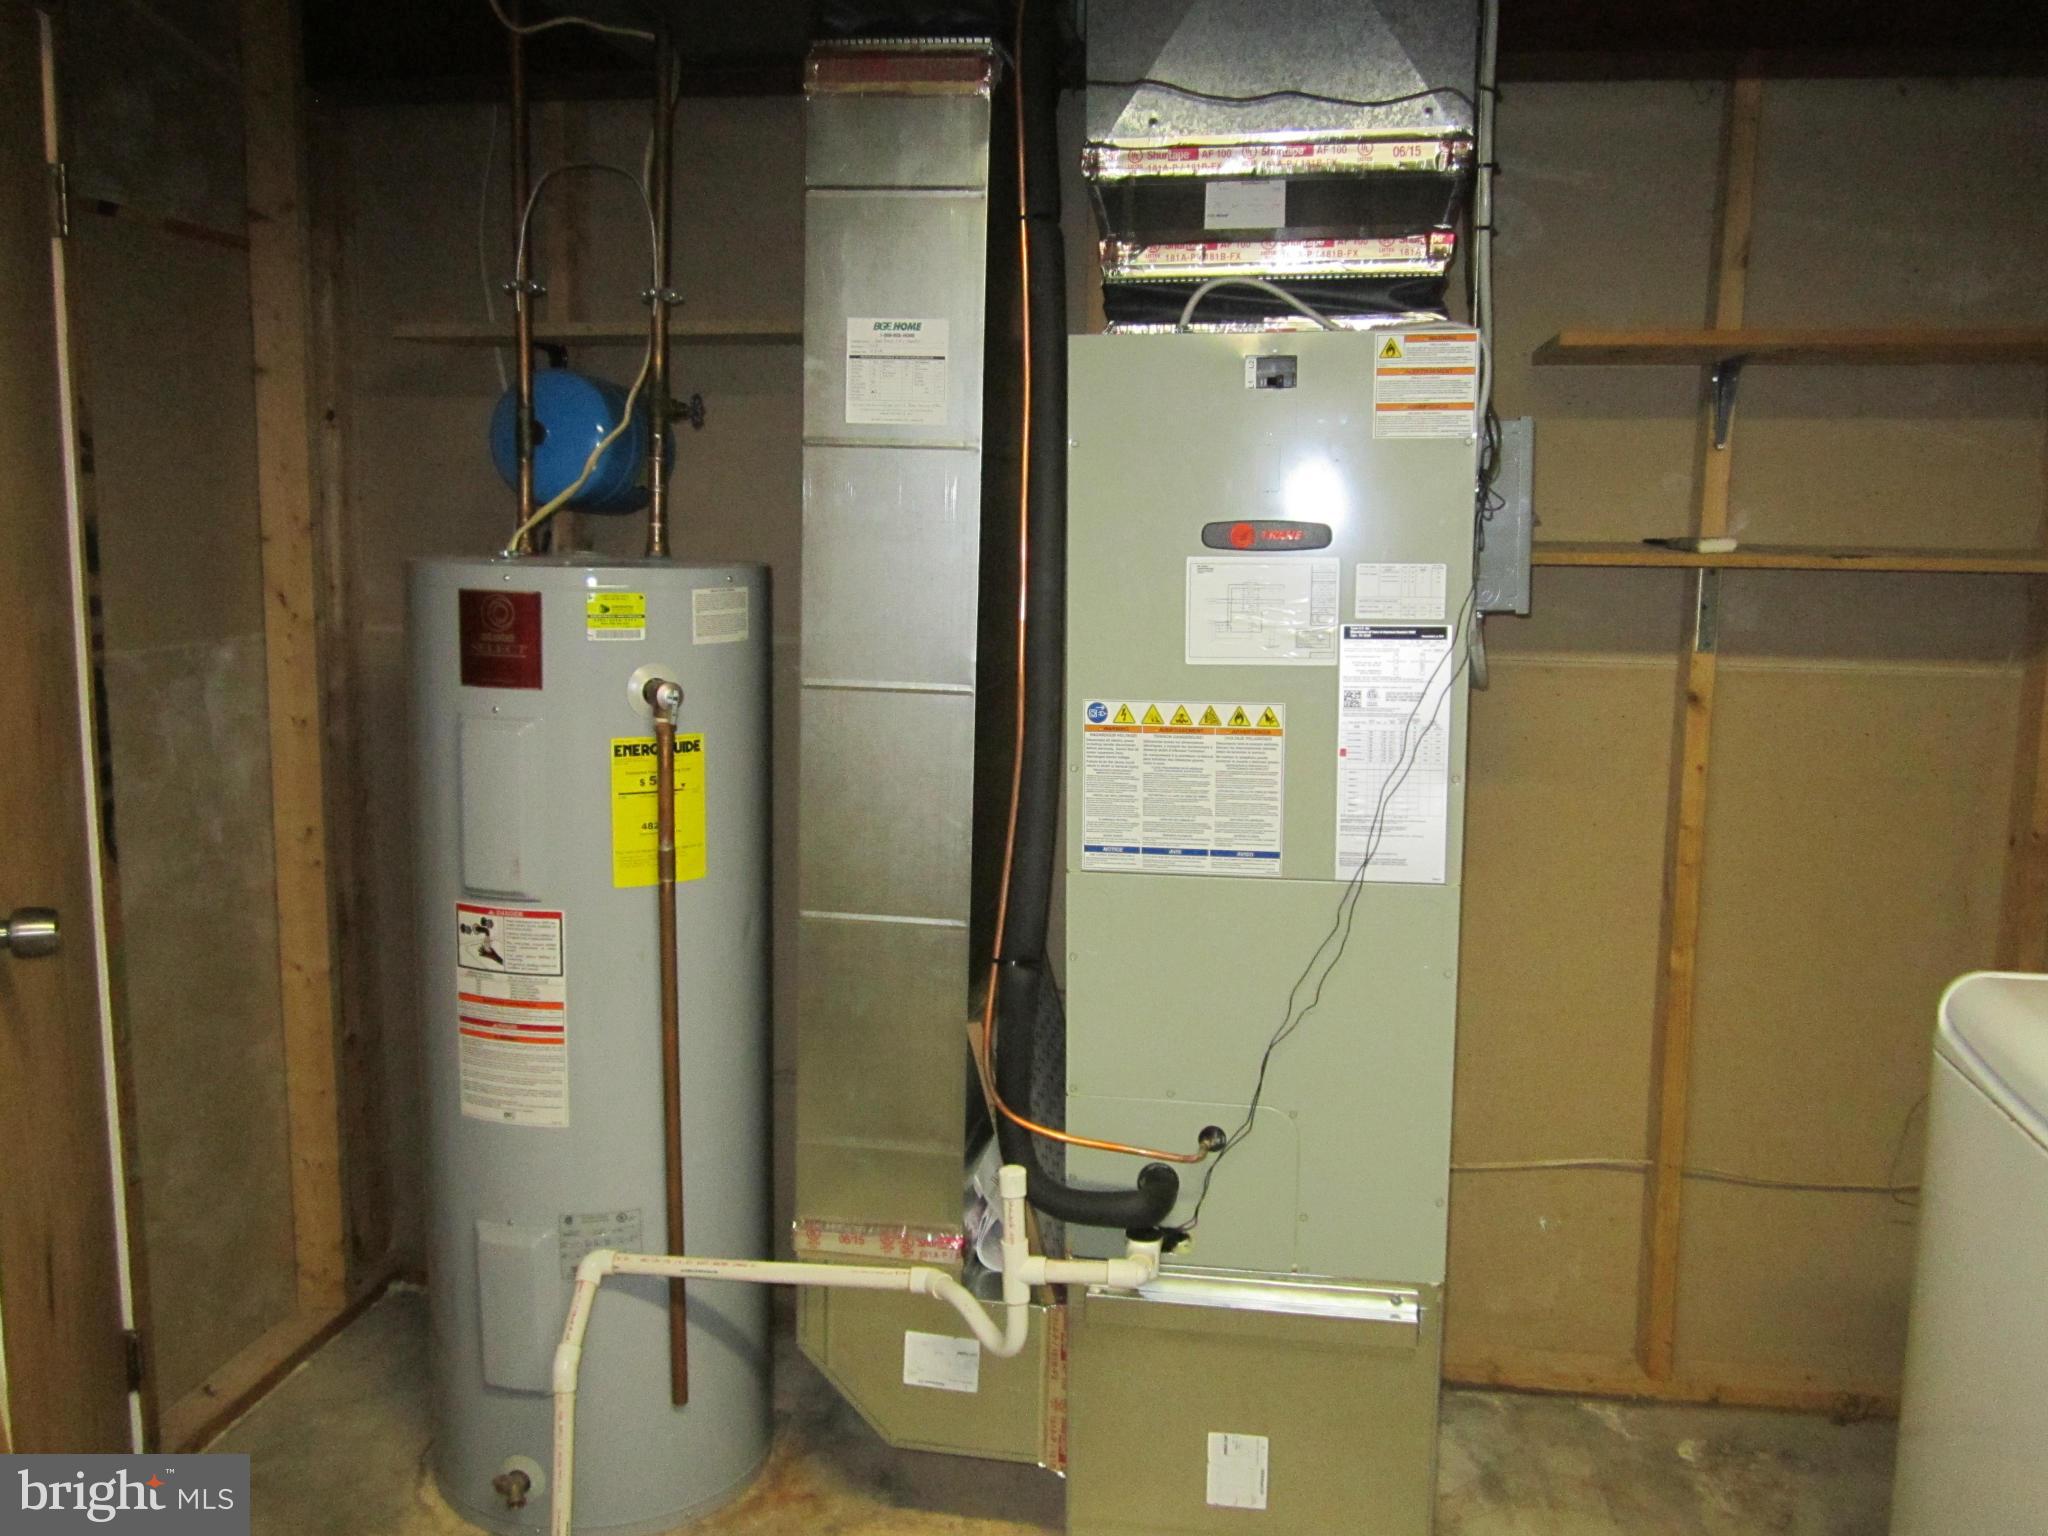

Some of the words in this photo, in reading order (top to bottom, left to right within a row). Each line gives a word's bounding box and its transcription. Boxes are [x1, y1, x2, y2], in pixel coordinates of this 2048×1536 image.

[1147, 151, 1190, 162] Shurtape
[1202, 150, 1216, 158] AF
[1217, 149, 1232, 158] 100
[1316, 145, 1331, 154] AF
[1333, 145, 1347, 154] 100
[1392, 145, 1421, 157] 06/15
[893, 322, 922, 331] HOME
[613, 739, 701, 758] ENERGUIDE
